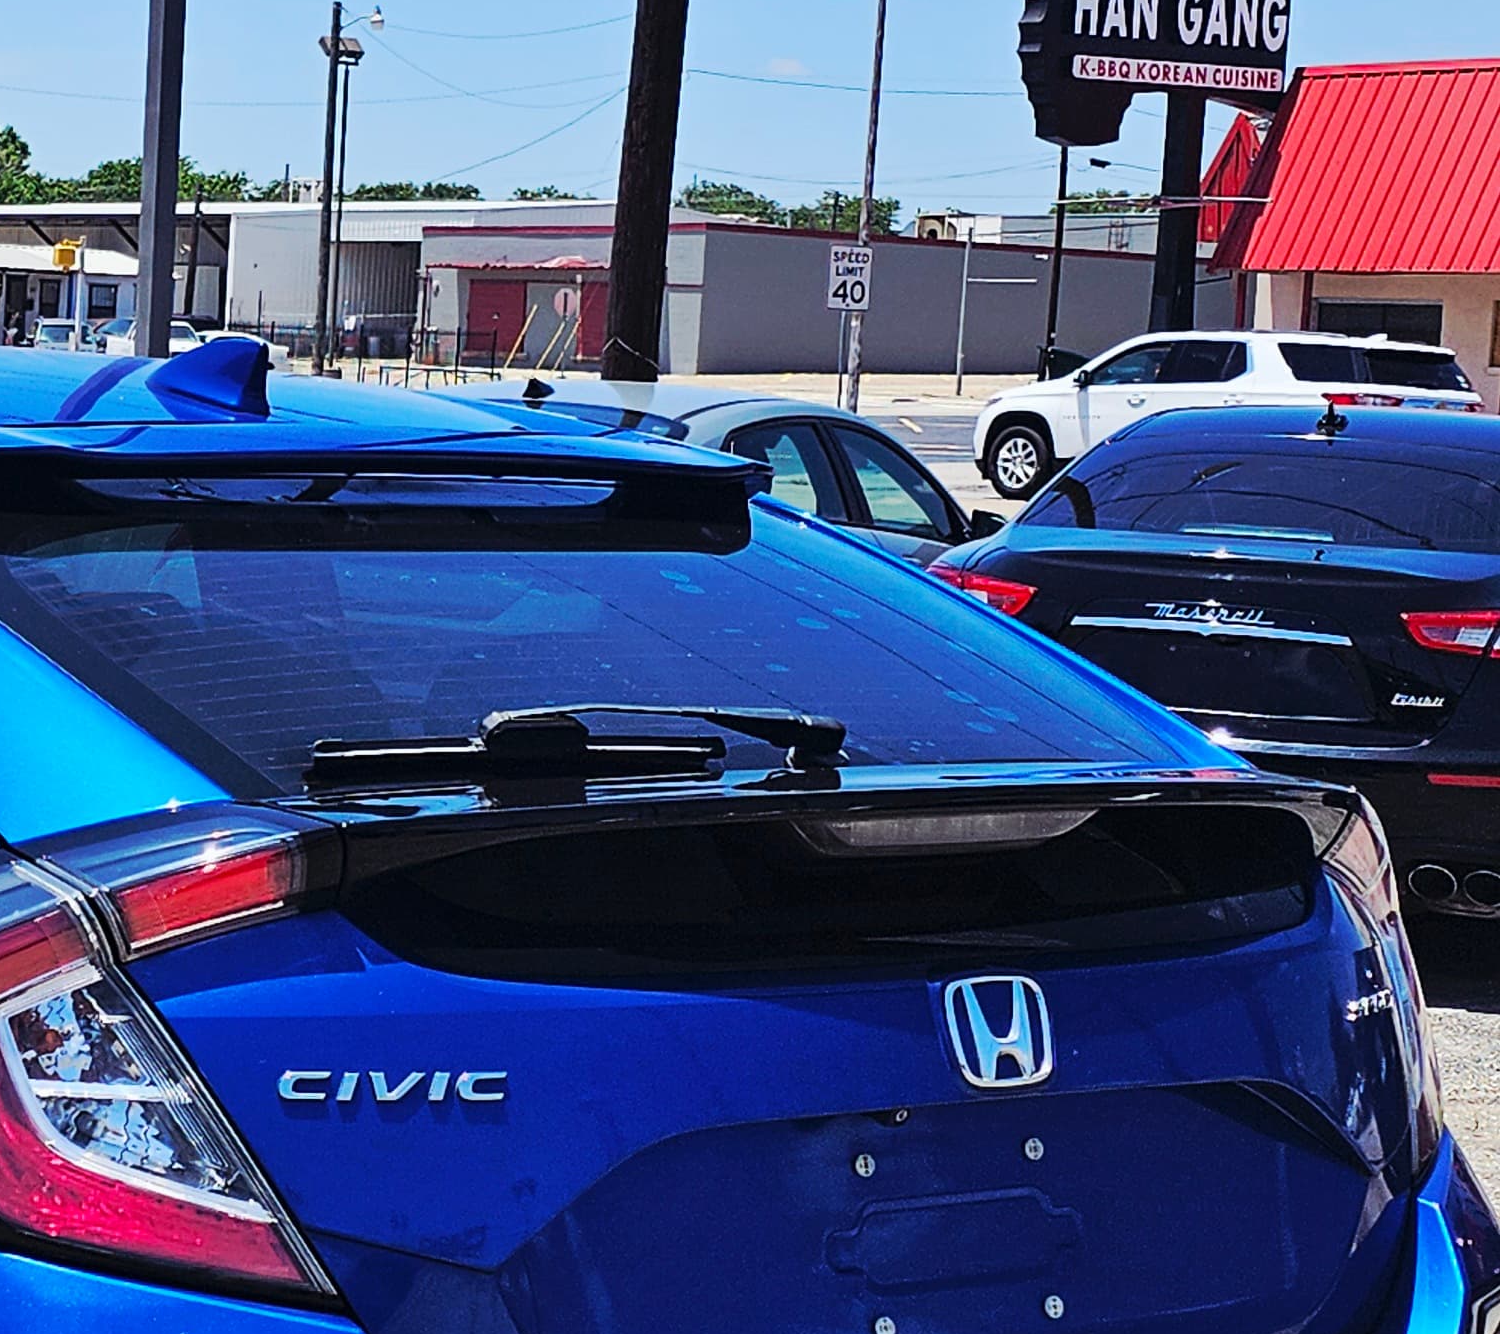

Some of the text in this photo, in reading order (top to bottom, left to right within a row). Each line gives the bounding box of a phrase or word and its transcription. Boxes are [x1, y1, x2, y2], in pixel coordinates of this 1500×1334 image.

[1079, 58, 1278, 89] K-BBQ KOREAN CUISINE
[833, 251, 870, 264] SPEED
[835, 265, 865, 277] LIMIT
[832, 279, 866, 304] 40
[278, 1069, 508, 1102] CIVIC
